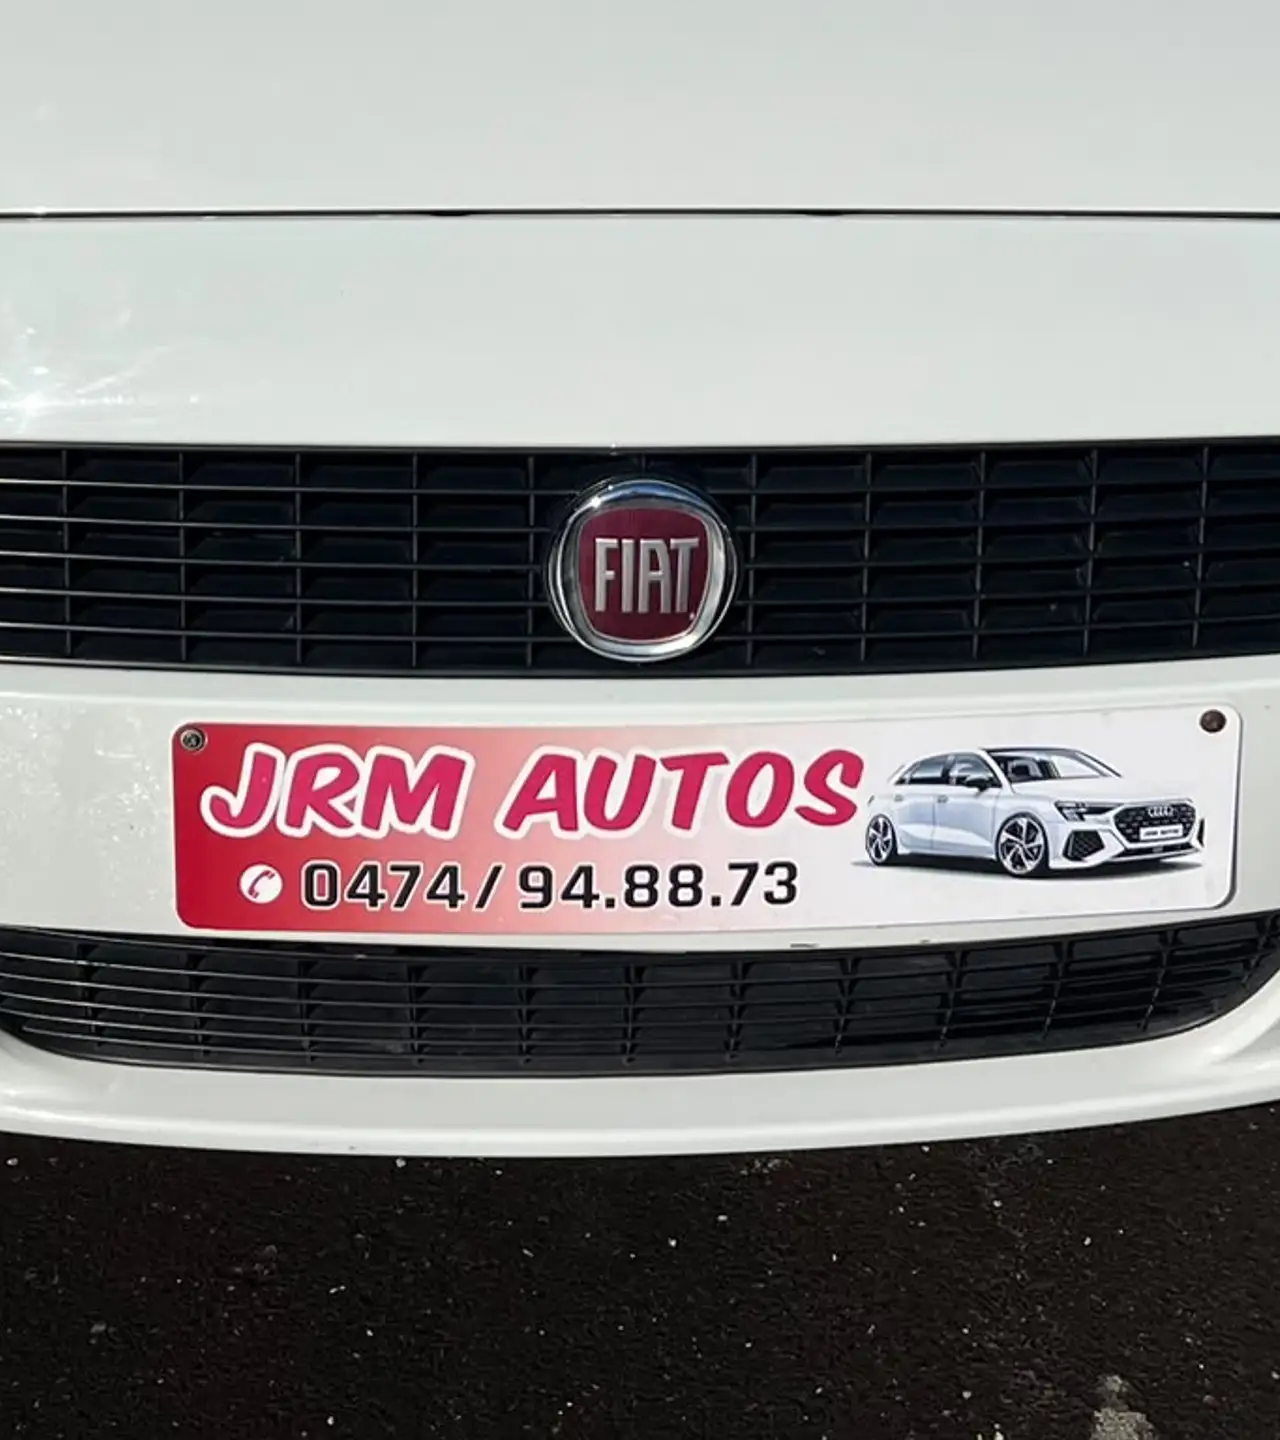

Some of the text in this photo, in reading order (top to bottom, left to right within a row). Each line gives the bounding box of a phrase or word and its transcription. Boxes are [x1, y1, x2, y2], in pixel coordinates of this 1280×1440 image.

[594, 537, 699, 614] FIAT
[202, 744, 866, 839] JRM AUTOS
